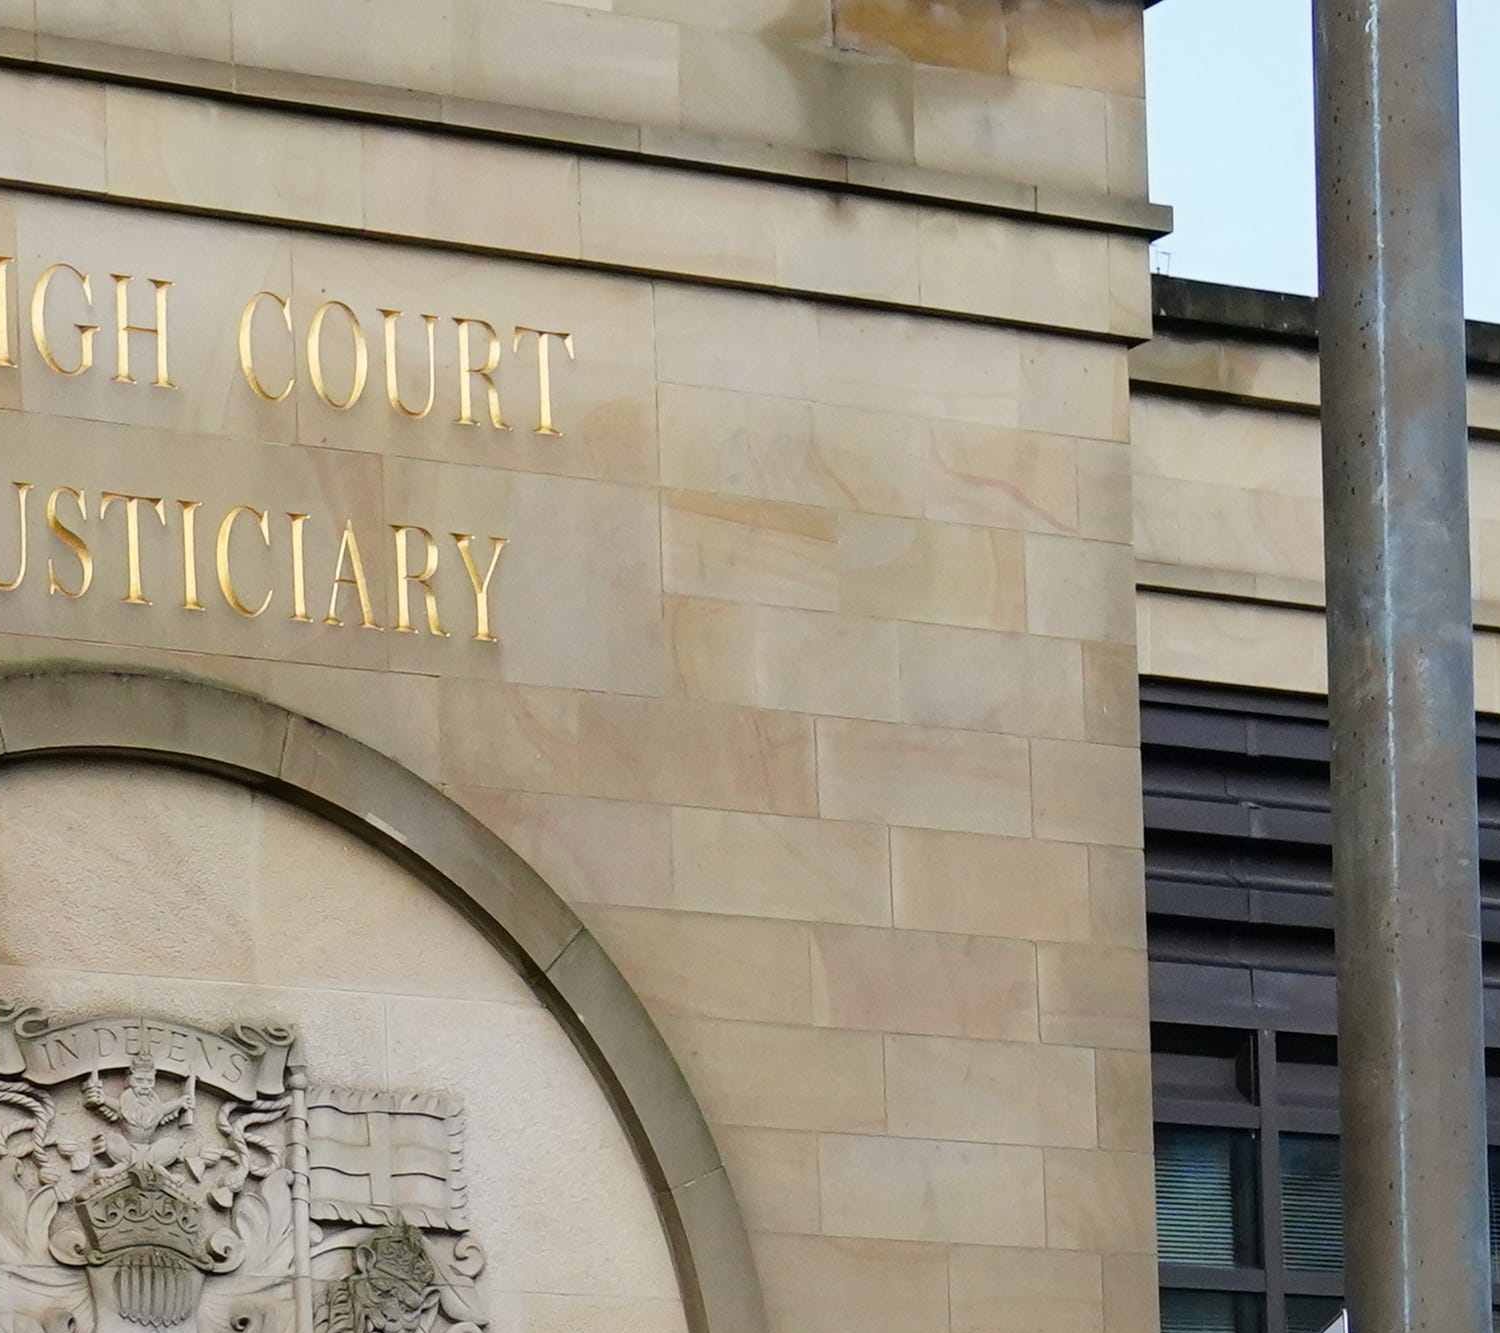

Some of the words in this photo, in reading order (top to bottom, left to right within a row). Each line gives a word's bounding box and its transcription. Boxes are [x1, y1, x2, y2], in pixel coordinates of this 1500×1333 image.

[238, 290, 576, 438] COURT
[37, 1033, 80, 1071] IN
[93, 1025, 251, 1084] DEFENS
